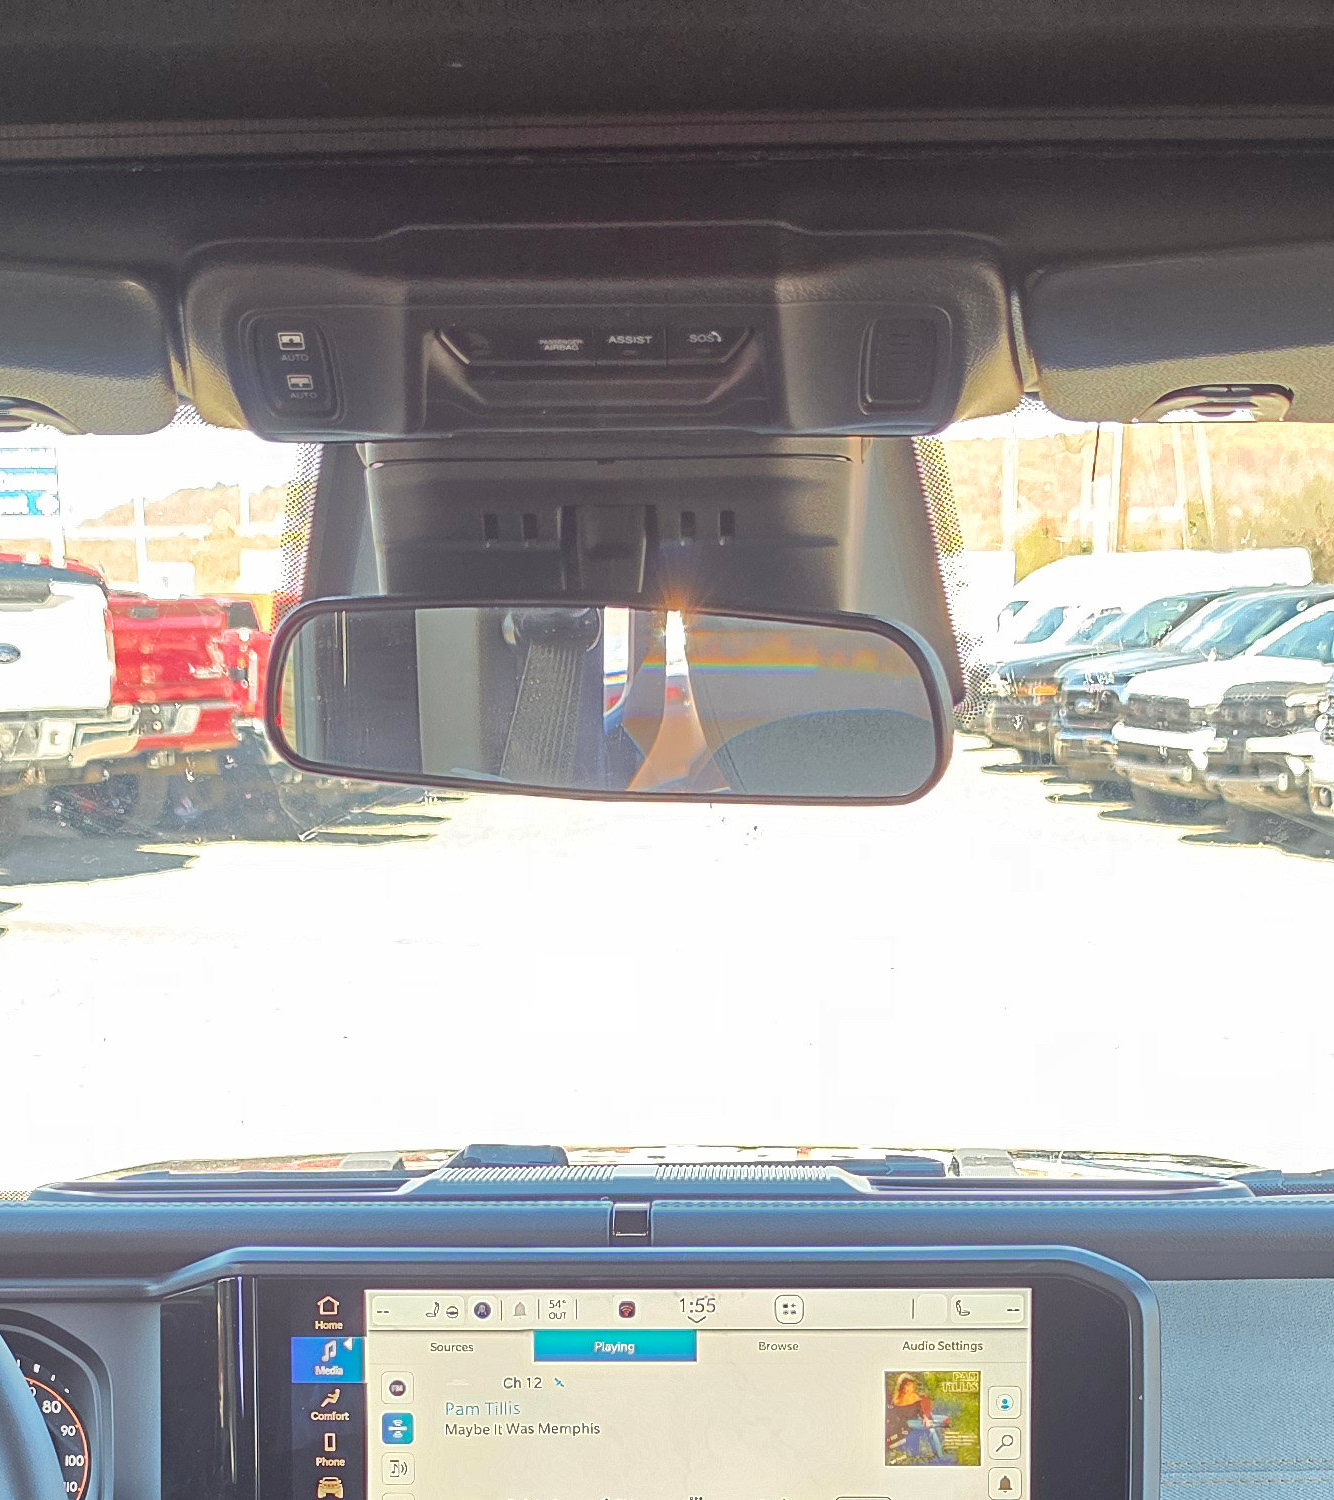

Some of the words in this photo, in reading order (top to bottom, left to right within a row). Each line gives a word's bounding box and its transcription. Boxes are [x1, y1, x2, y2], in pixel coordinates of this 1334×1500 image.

[608, 335, 653, 344] ASSIST
[689, 334, 714, 343] SOS
[548, 1299, 567, 1309] 54°
[679, 1297, 716, 1313] 1:55
[548, 1312, 567, 1320] OUT
[315, 1320, 343, 1330] Home
[430, 1342, 474, 1353] Sources
[594, 1341, 635, 1355] Playing
[758, 1342, 799, 1351] Browse
[902, 1340, 935, 1351] Audio
[937, 1340, 983, 1353] Settings
[314, 1365, 343, 1376] Media
[503, 1375, 522, 1389] Ch
[527, 1375, 543, 1389] 12
[42, 1400, 62, 1414] 80
[445, 1402, 480, 1415] Pam
[484, 1401, 521, 1415] Tillis
[310, 1411, 349, 1421] Comfort
[60, 1425, 76, 1437] 90
[445, 1423, 491, 1438] Maybe
[494, 1423, 503, 1435] It
[506, 1423, 535, 1435] Was
[538, 1422, 601, 1436] Memphis
[65, 1454, 84, 1467] 100
[315, 1457, 345, 1467] Phone
